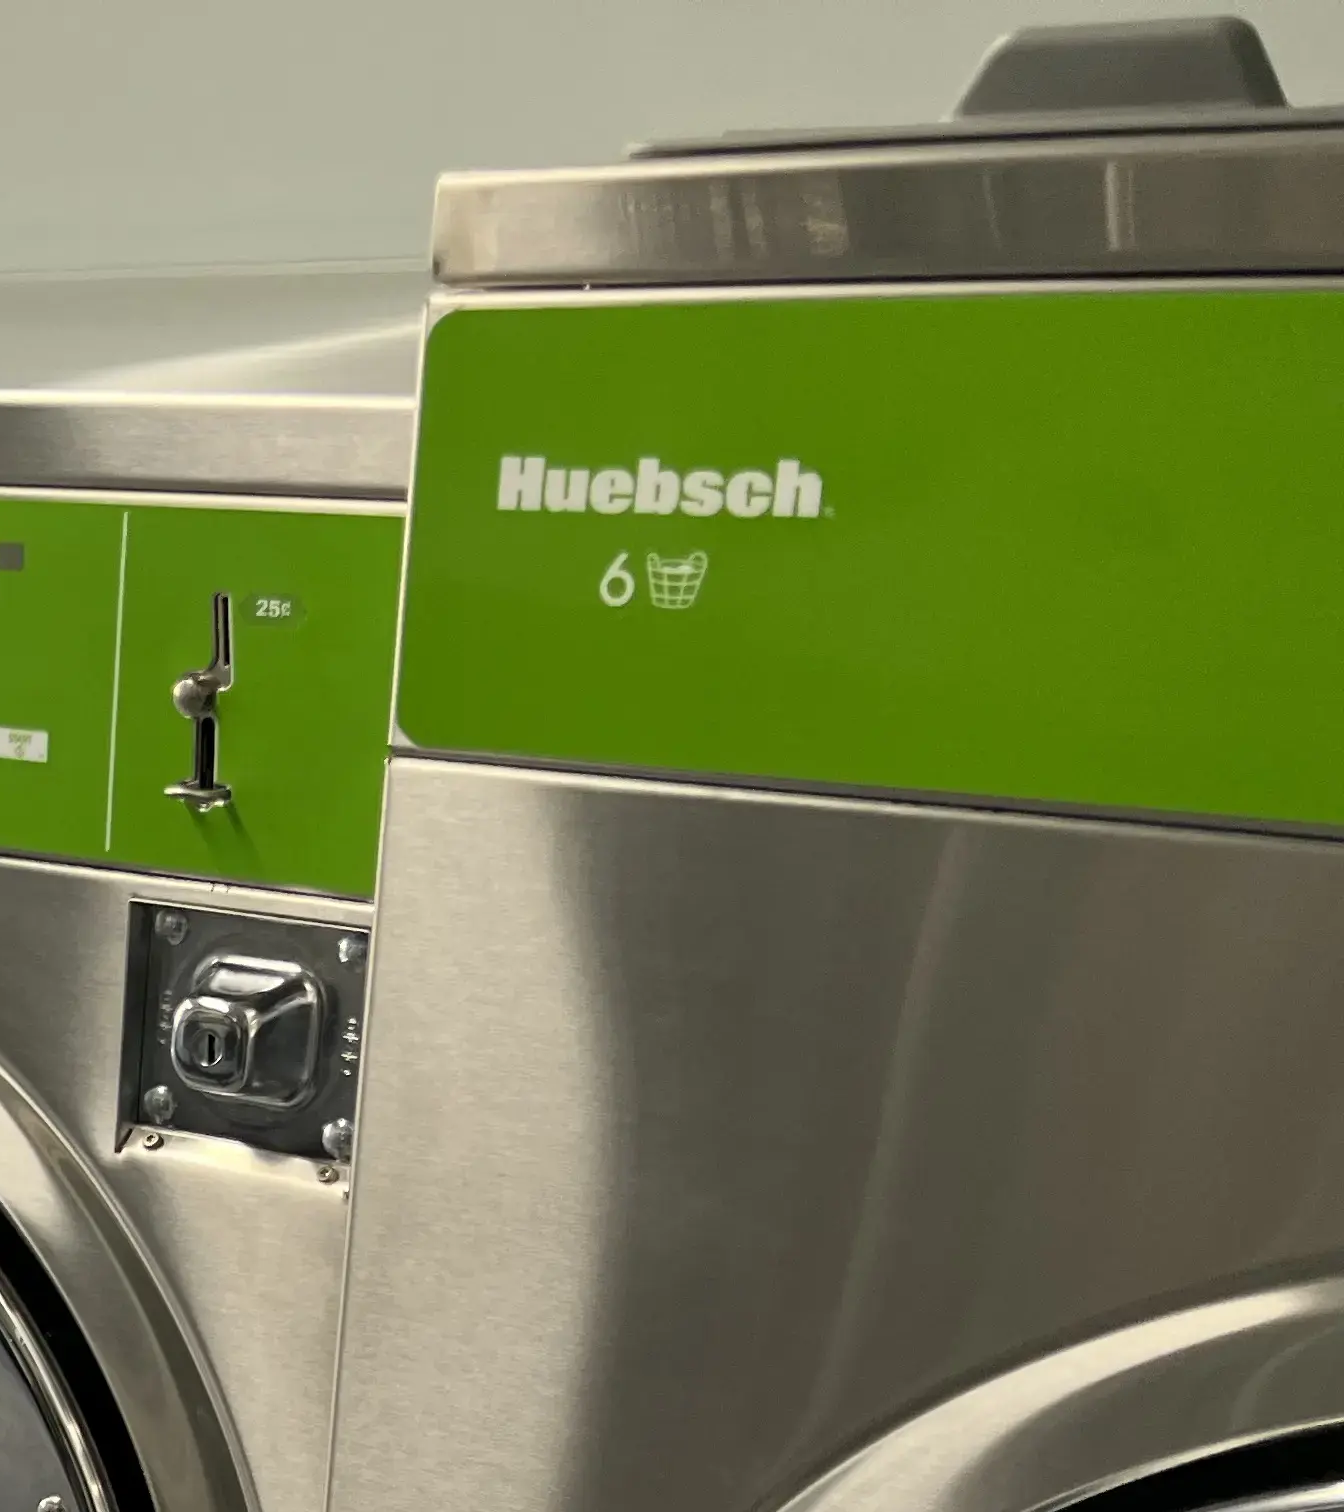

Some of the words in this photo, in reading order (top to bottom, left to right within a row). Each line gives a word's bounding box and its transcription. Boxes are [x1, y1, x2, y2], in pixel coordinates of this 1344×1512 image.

[496, 454, 823, 518] Huebsch
[599, 550, 635, 608] 6
[256, 599, 291, 618] 25¢
